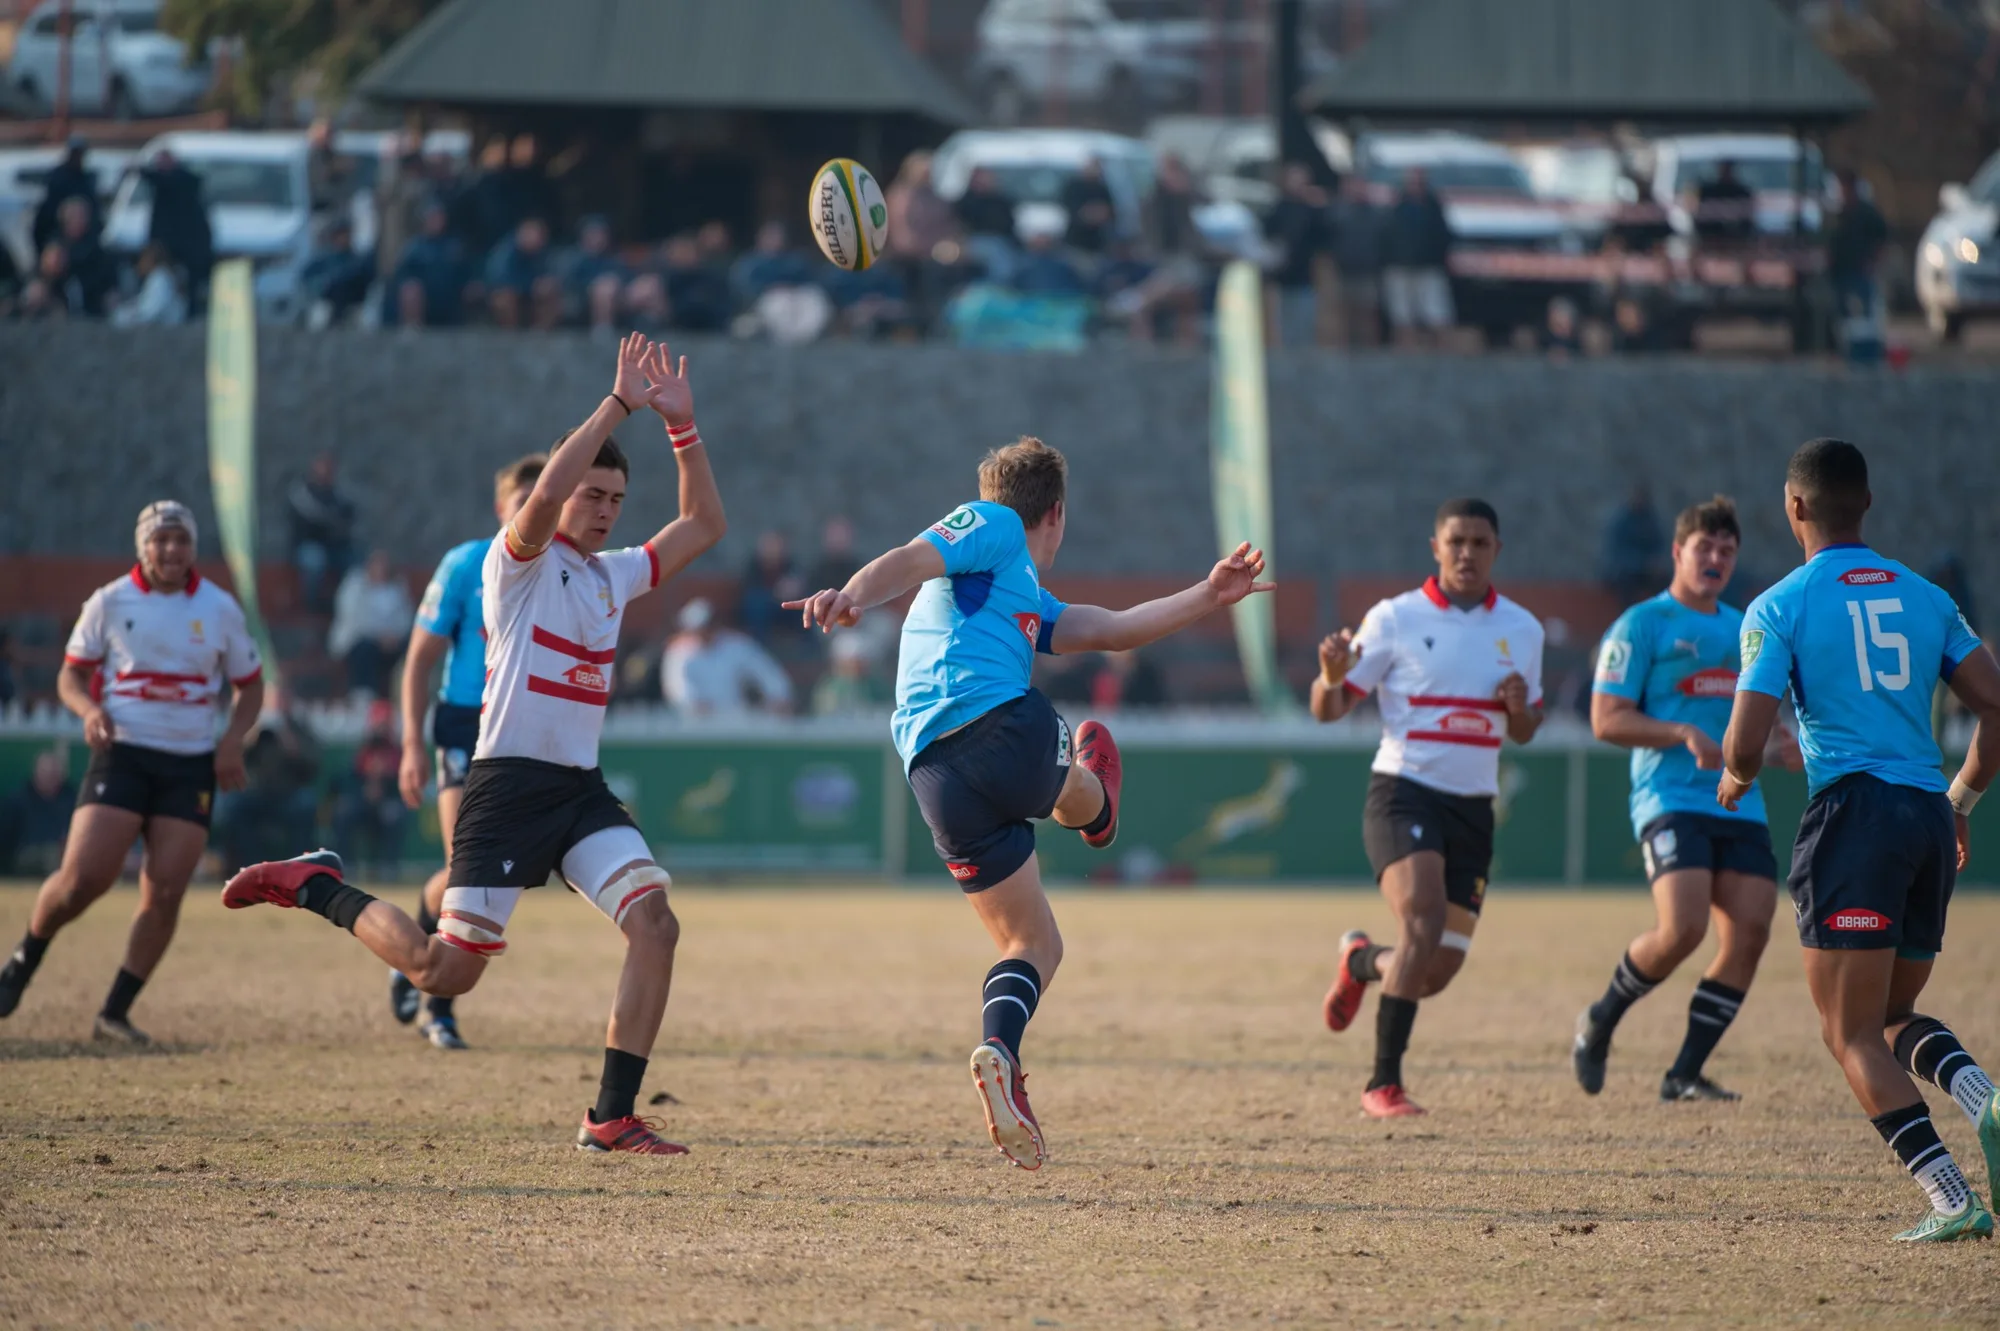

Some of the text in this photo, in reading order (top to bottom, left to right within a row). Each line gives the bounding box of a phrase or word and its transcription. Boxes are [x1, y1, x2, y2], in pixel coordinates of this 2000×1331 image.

[821, 181, 848, 266] GILBERT
[931, 525, 955, 541] PAR
[1848, 571, 1888, 583] OBARO
[1846, 598, 1910, 692] 15
[1836, 915, 1879, 928] OBARO
